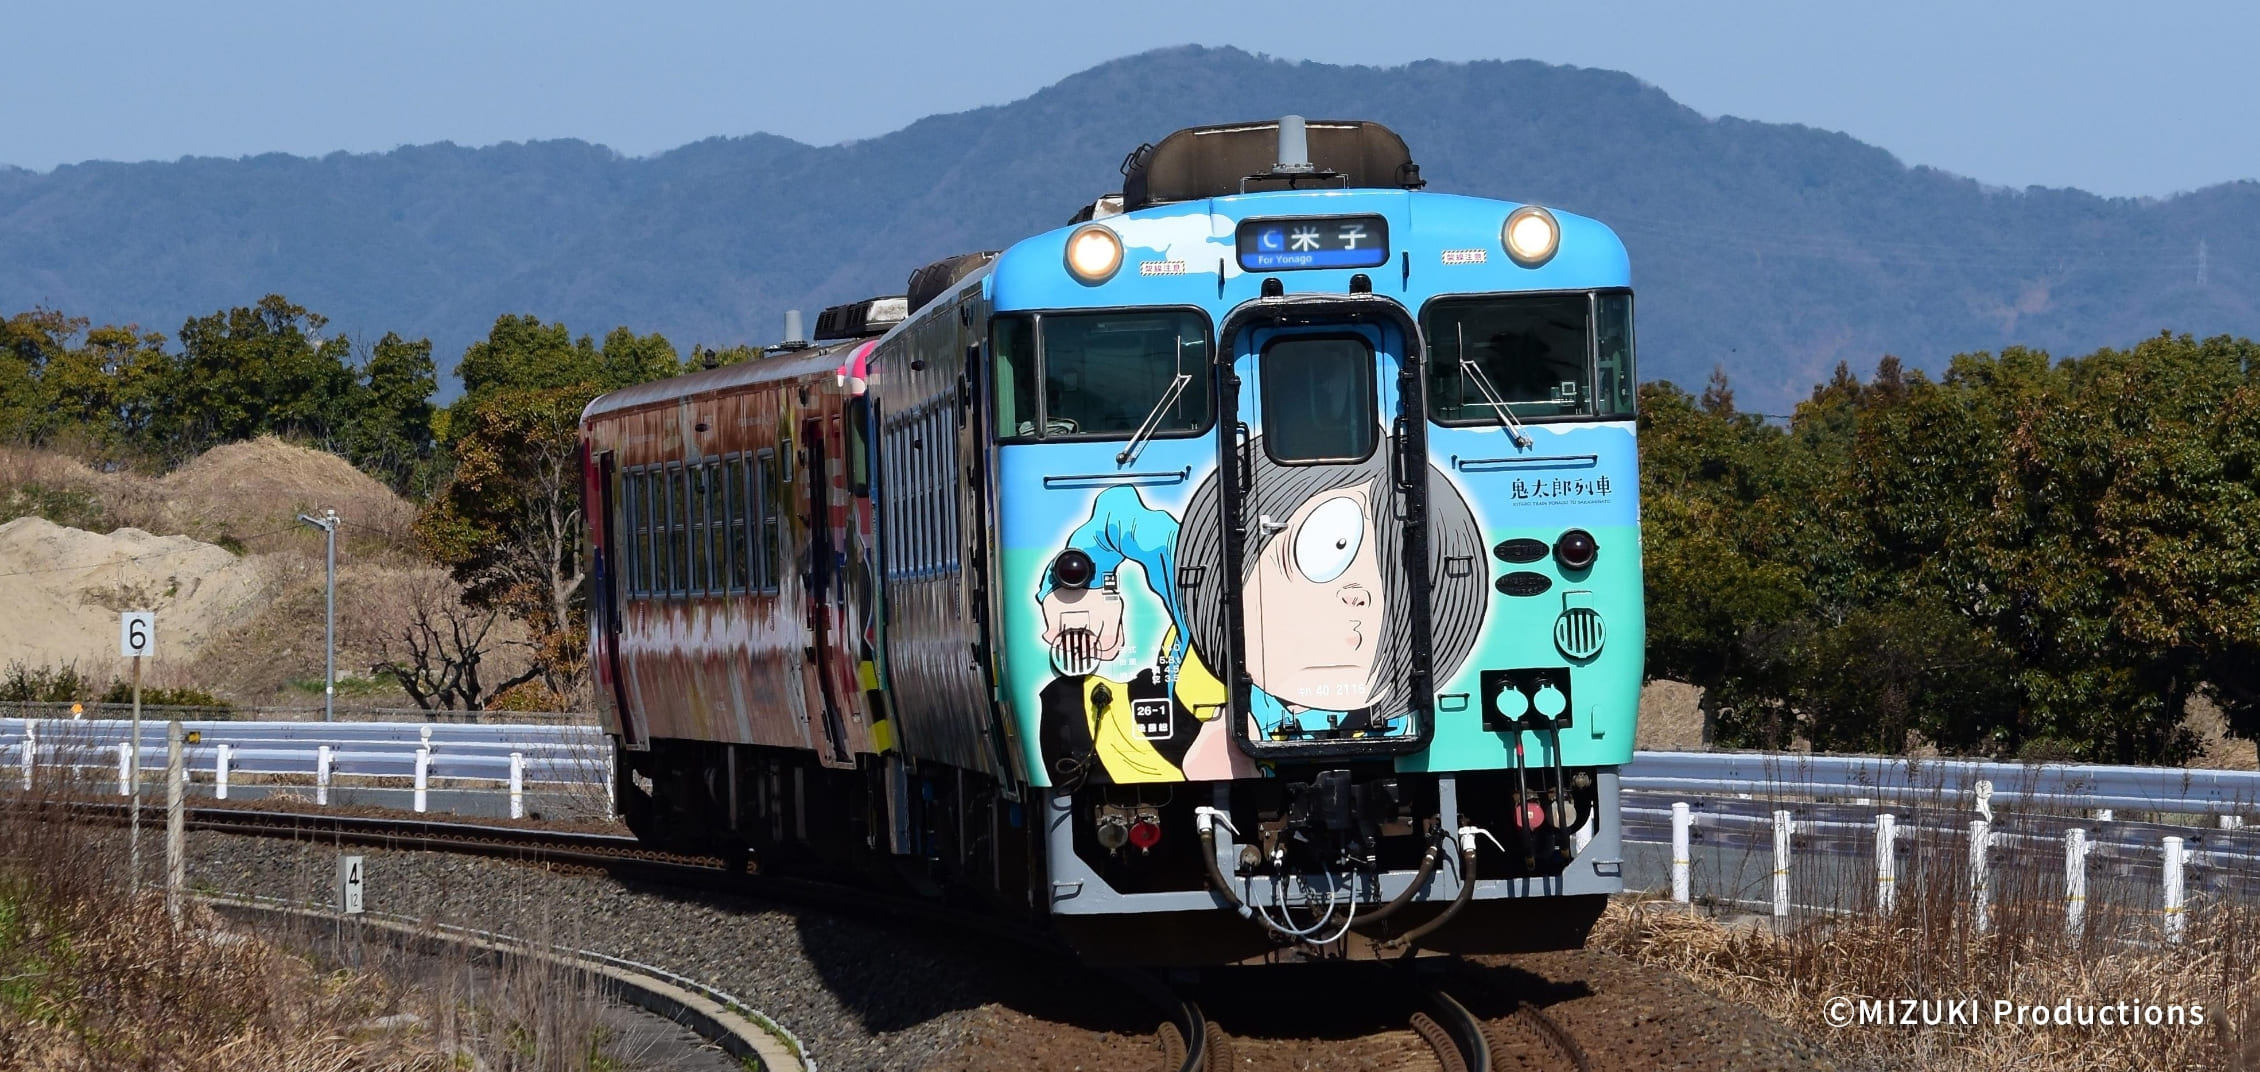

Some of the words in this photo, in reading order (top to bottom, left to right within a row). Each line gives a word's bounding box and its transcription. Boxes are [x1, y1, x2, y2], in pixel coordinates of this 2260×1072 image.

[1263, 229, 1278, 248] C
[1291, 225, 1367, 251] 米子
[1258, 255, 1273, 265] For
[1277, 254, 1312, 265] Yonago
[1510, 475, 1612, 499] 鬼太郎列車
[129, 618, 146, 650] 6
[1136, 705, 1166, 716] 26-1
[348, 862, 360, 886] 4
[350, 893, 359, 907] 12
